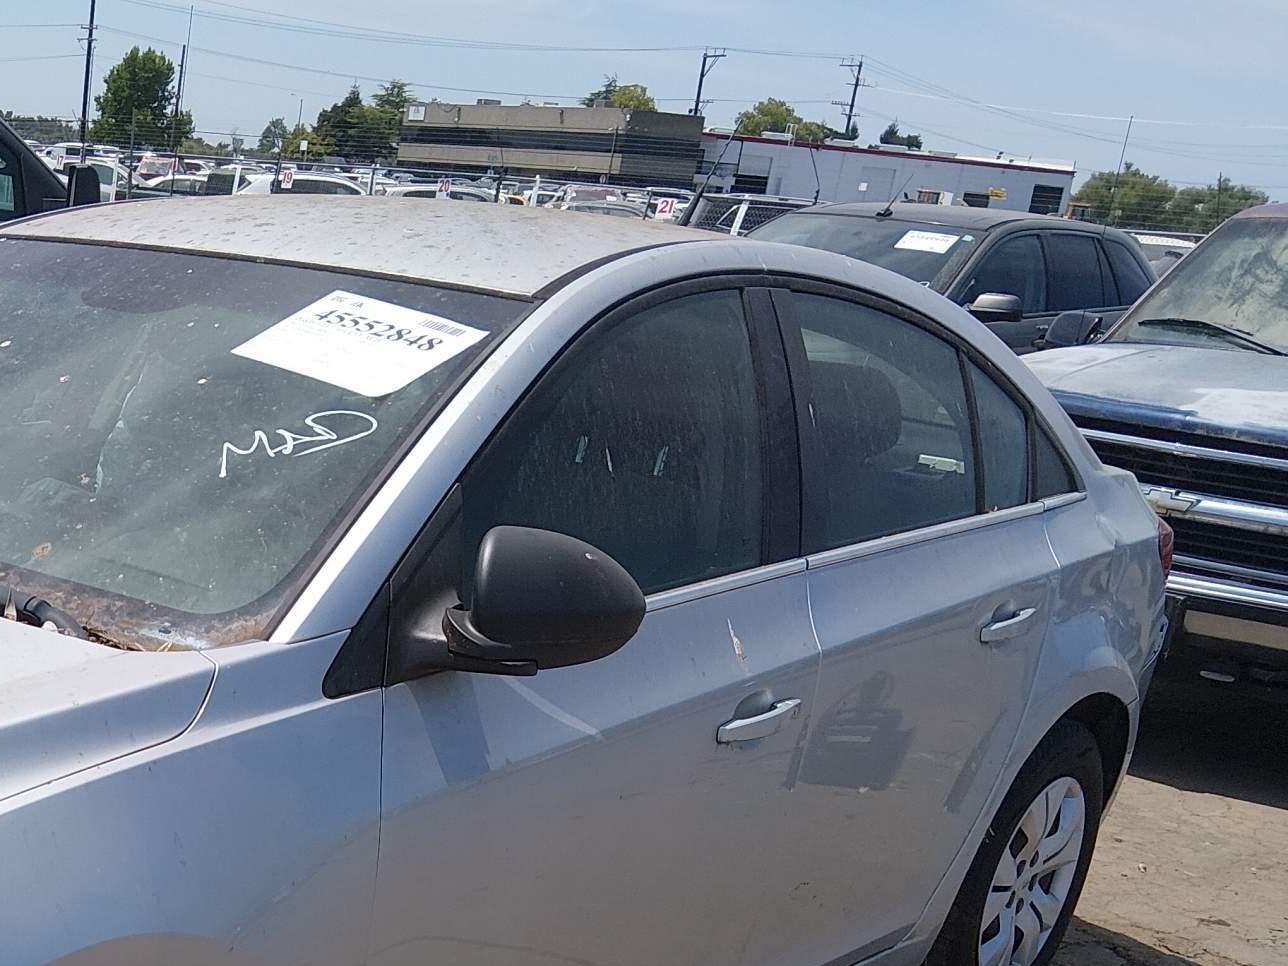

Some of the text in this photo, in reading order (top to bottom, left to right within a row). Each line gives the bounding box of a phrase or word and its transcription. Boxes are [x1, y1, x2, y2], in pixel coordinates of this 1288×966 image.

[283, 172, 293, 184] 19
[438, 180, 450, 192] 20
[658, 200, 673, 214] 21
[314, 309, 443, 351] 45552848
